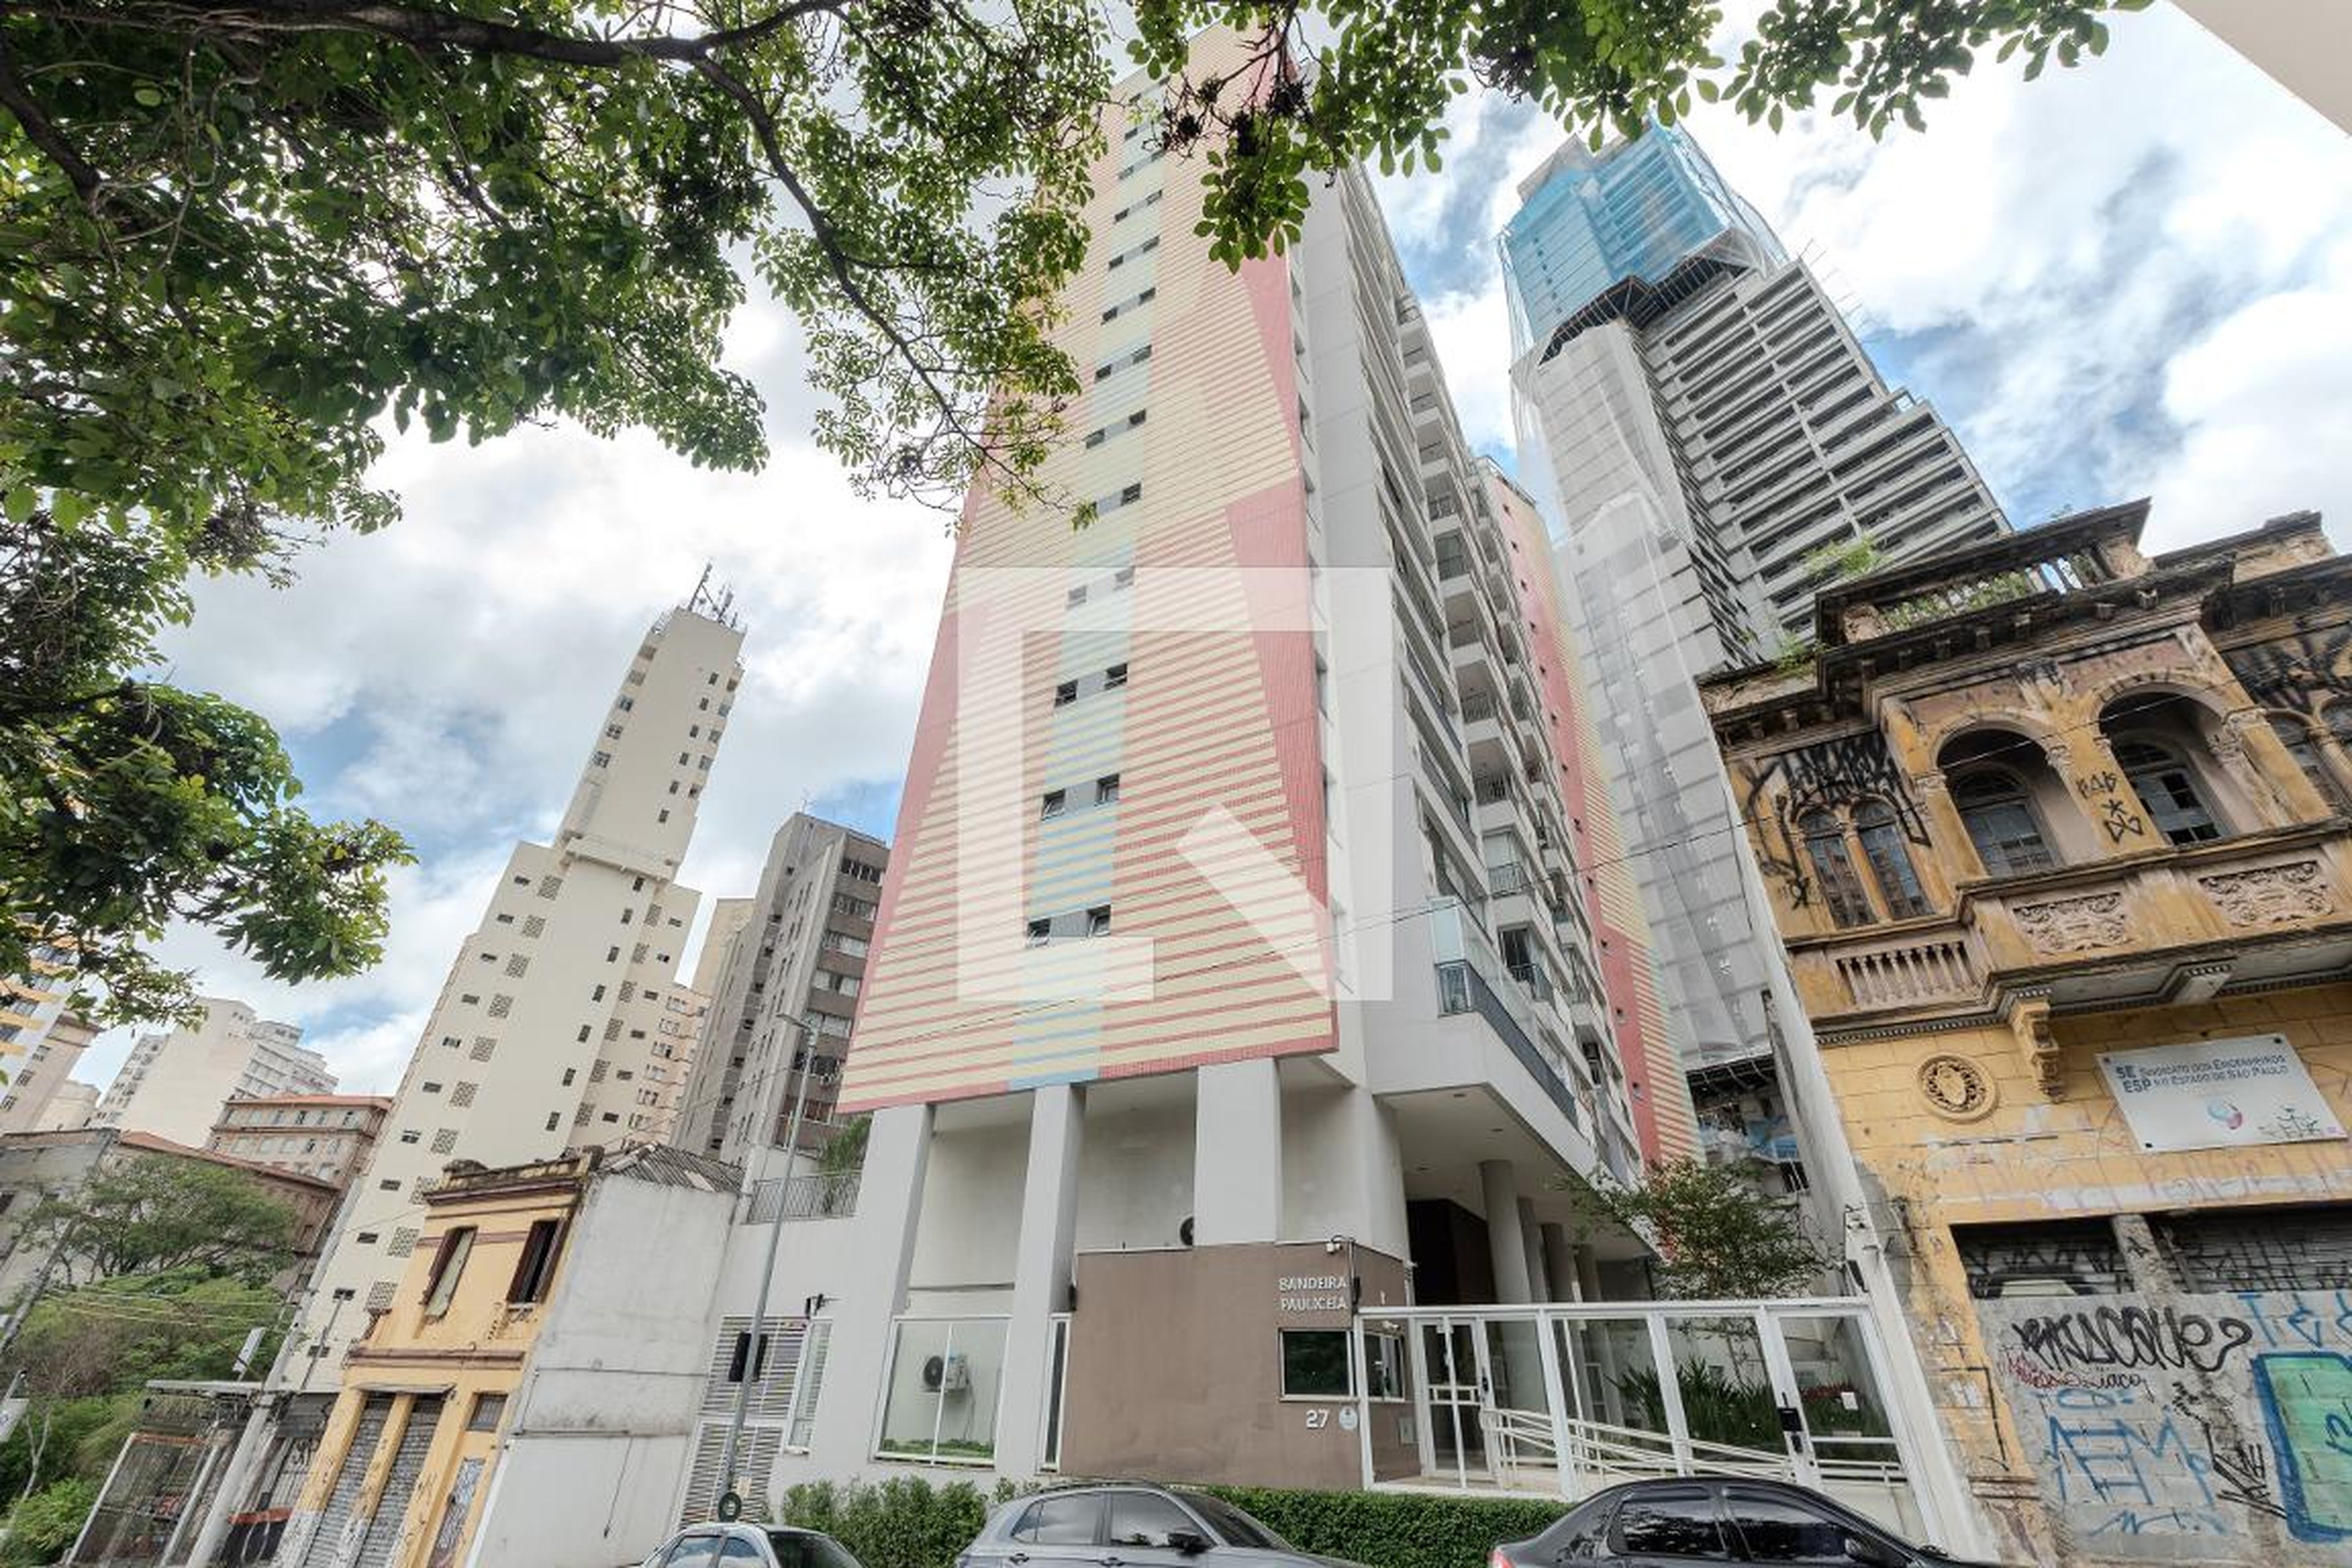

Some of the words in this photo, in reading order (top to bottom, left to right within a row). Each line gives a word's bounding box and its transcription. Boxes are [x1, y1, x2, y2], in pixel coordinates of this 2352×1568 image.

[2122, 1077, 2152, 1093] ESP
[1278, 1276, 1347, 1291] BANDEIRA
[1305, 1409, 1330, 1429] 27
